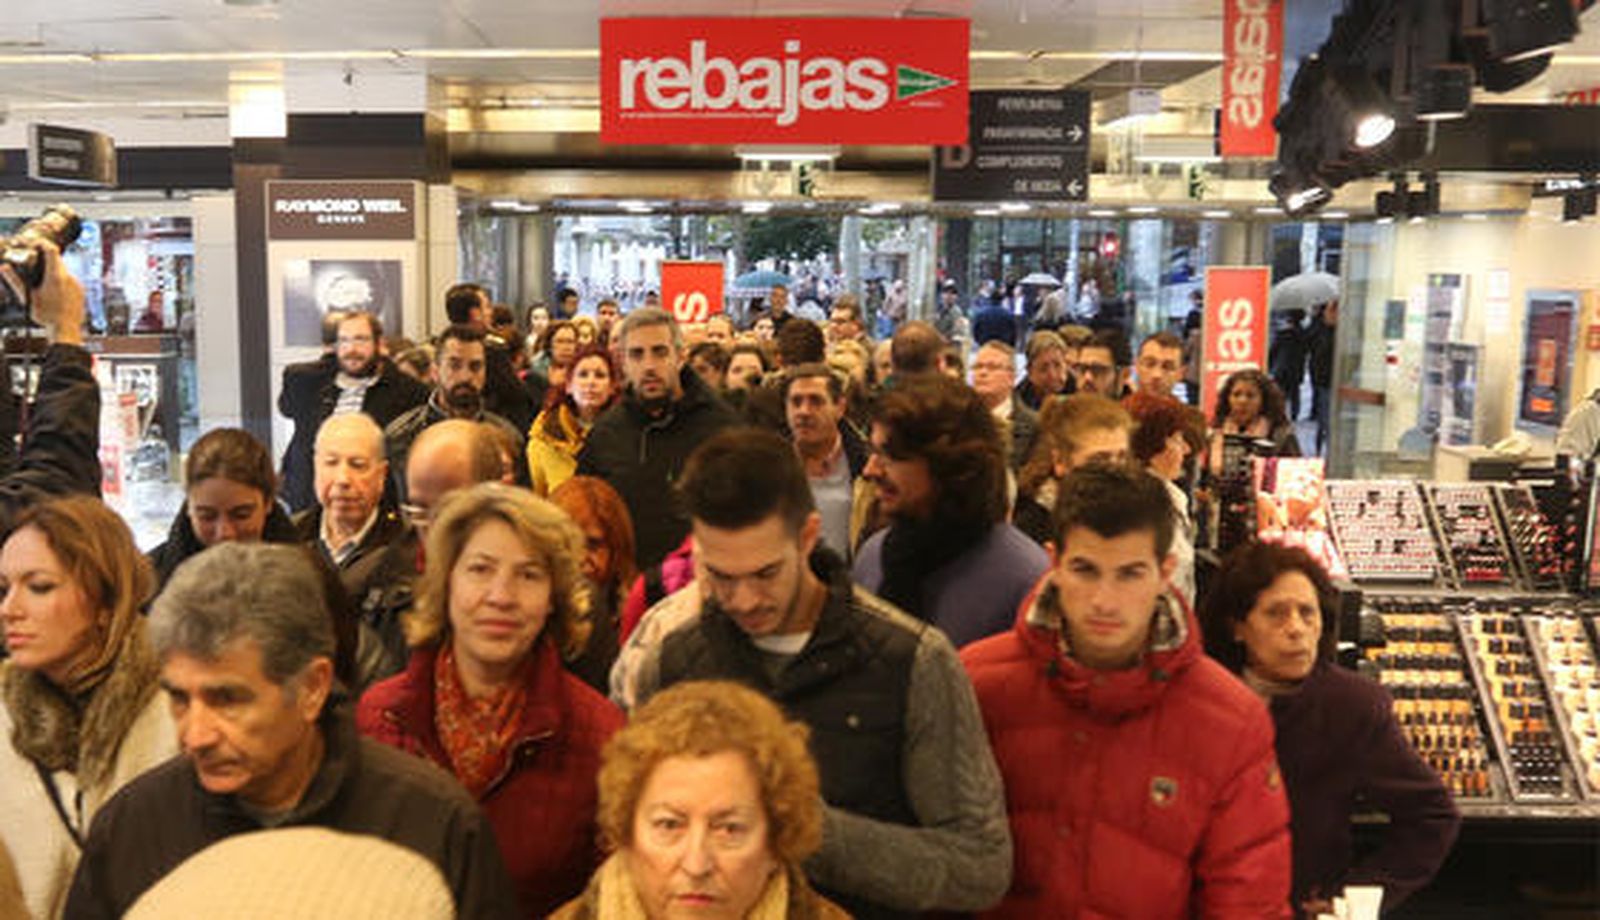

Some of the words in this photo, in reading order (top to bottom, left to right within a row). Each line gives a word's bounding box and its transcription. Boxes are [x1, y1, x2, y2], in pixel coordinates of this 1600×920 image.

[619, 40, 889, 125] rebajas
[275, 199, 360, 212] RAYMOND
[363, 199, 407, 212] WEIL
